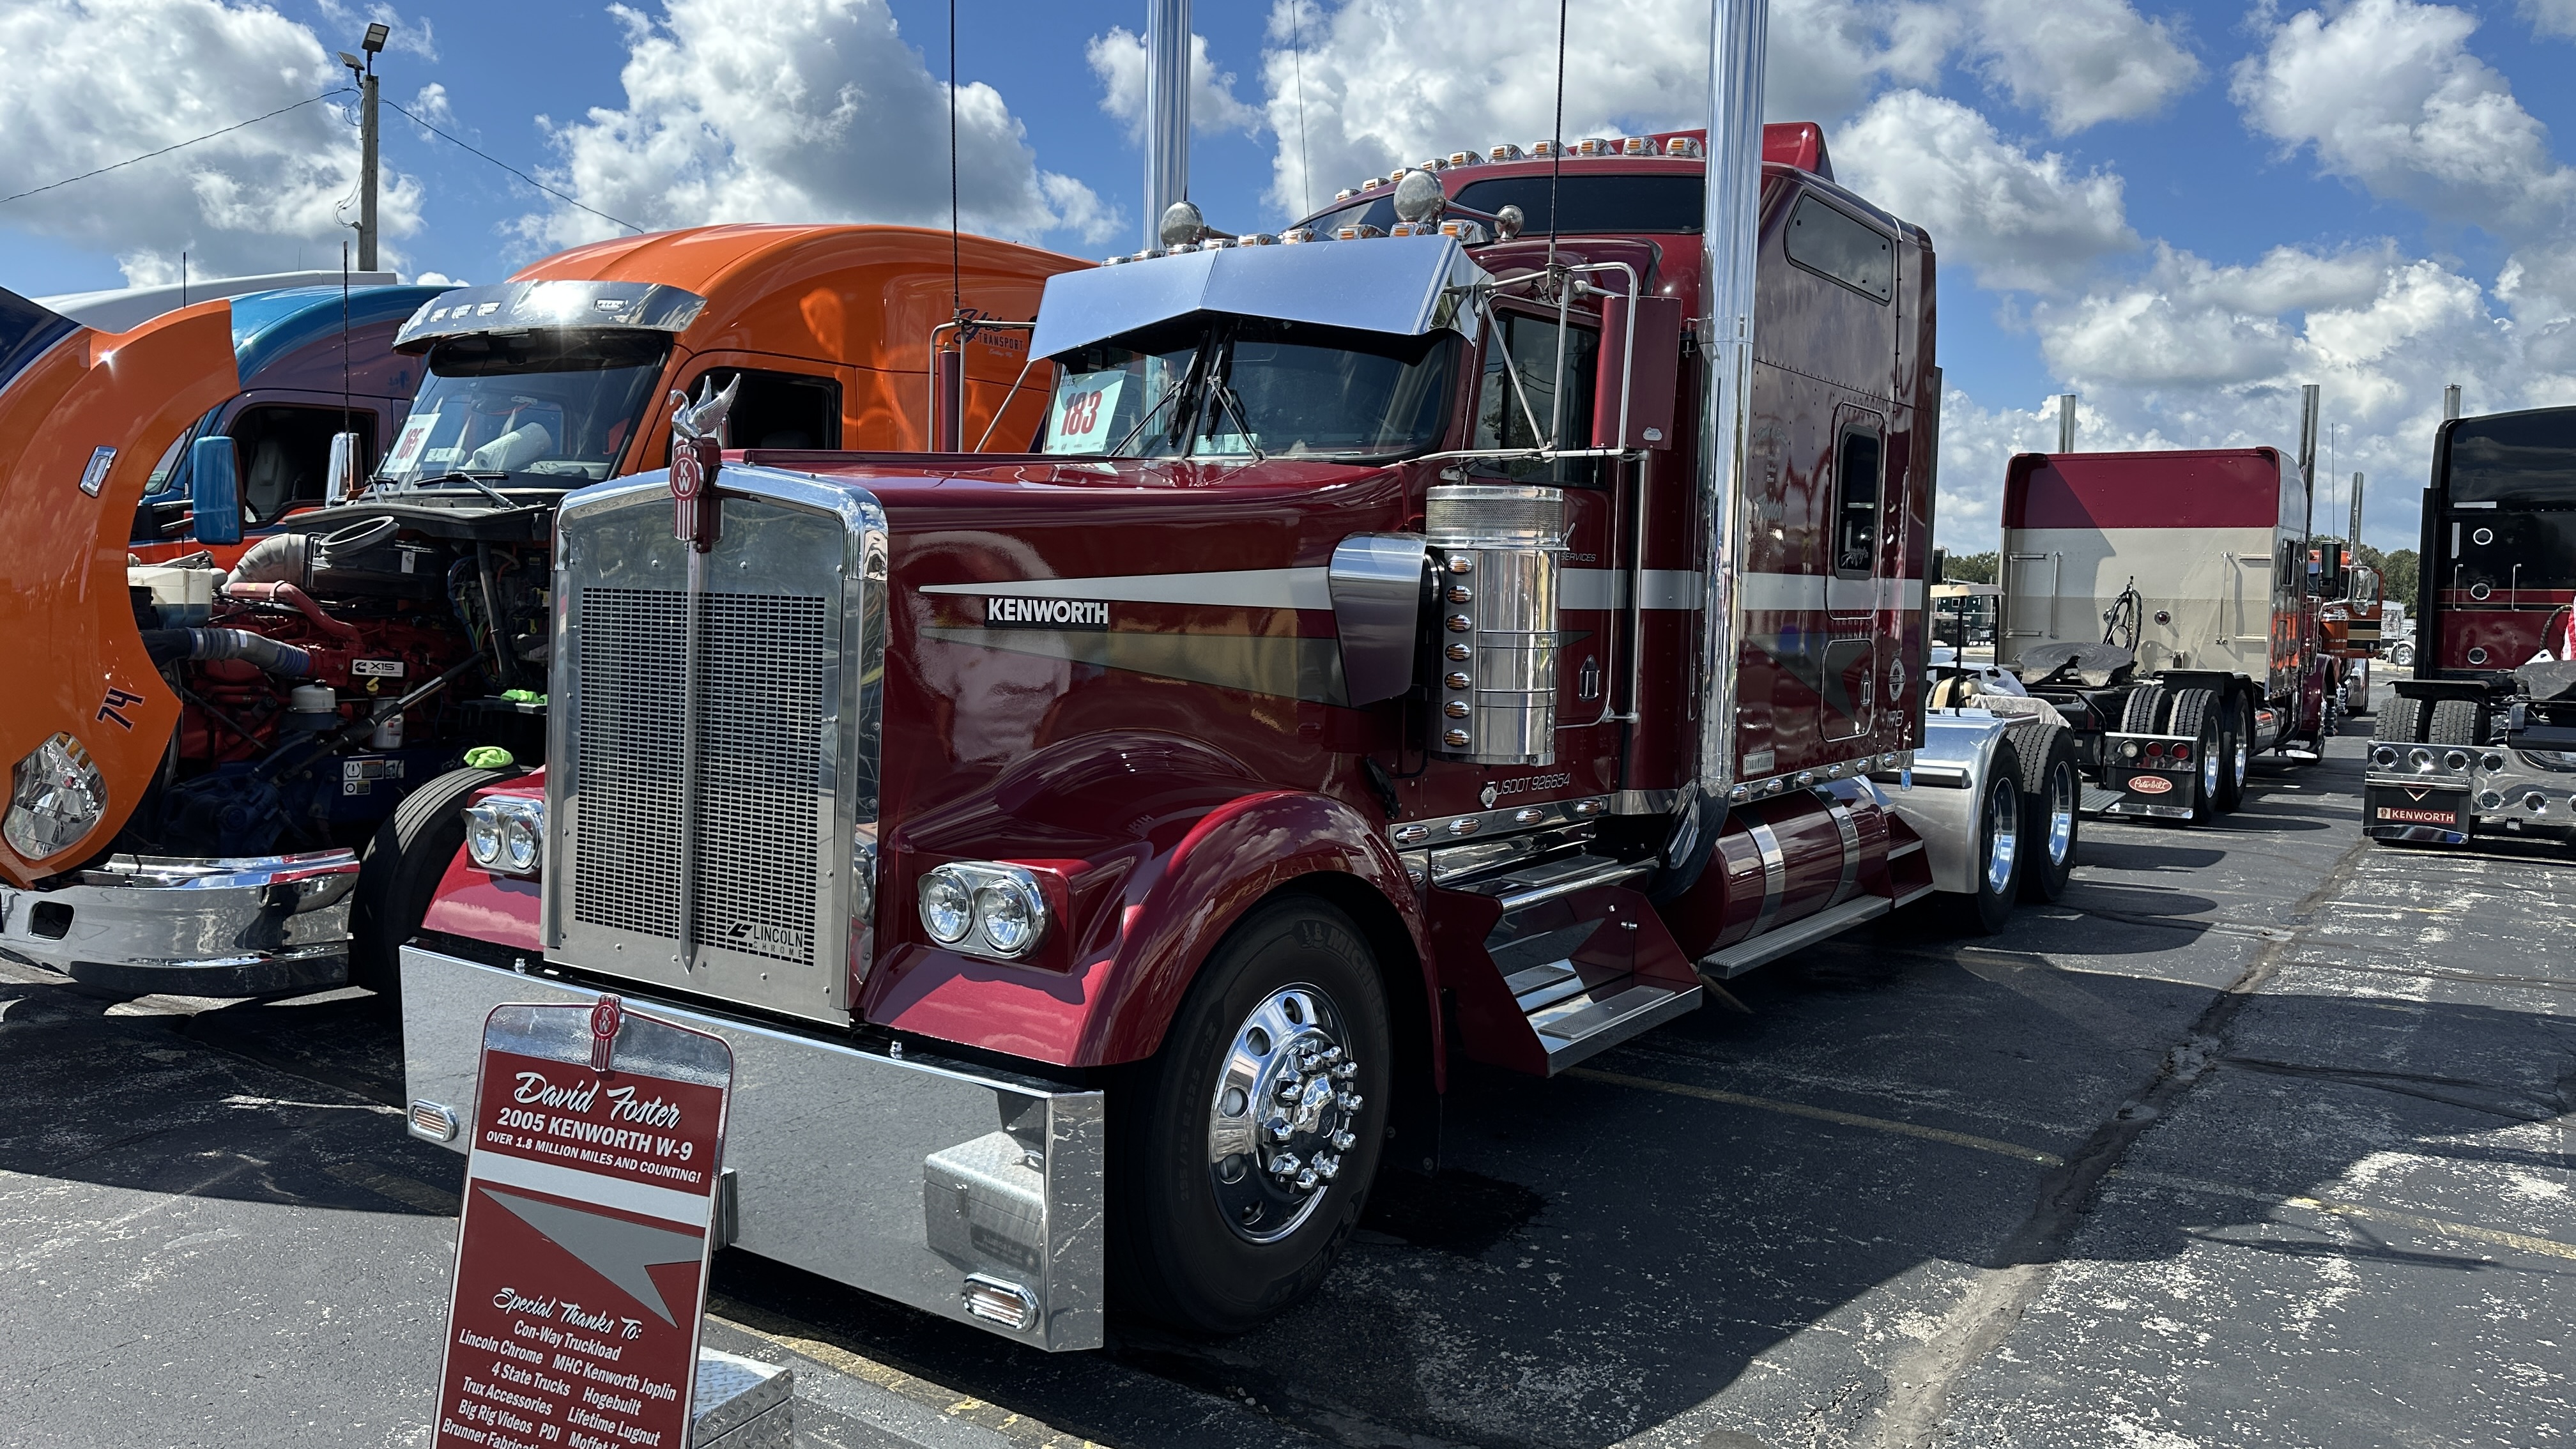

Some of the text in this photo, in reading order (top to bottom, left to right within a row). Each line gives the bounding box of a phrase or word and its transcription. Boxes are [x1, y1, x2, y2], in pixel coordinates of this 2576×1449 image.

[978, 333, 1023, 350] TRANSPORT
[1061, 378, 1076, 387] 2025
[1061, 390, 1102, 436] 183
[988, 598, 1108, 624] KENWORTH
[369, 662, 395, 671] X15
[95, 686, 146, 732] 74
[1496, 772, 1570, 795] USDOT 926654
[2134, 778, 2169, 790] Peterbilt
[2392, 809, 2454, 822] KENWORTH
[753, 940, 802, 958] CHROME
[754, 924, 803, 948] LINCOLN
[514, 1072, 681, 1129] David Foster
[497, 1108, 693, 1161] 2005 KENWORTH W-9
[486, 1130, 702, 1183] OVER 1.8 MILLION MILES AND COUNTING!
[493, 1287, 643, 1340] Special Thanks To:
[514, 1319, 622, 1361] Con-Way Truckload
[459, 1328, 677, 1401] Lincoln Chrome MHC Kenworth Joplin
[491, 1361, 641, 1416] 4 State Trucks Hogebuilt
[441, 1418, 487, 1444] Brunner
[458, 1399, 608, 1449] Big Rig Videos PDI Moffet
[463, 1376, 661, 1446] Trux Accessories Lifetime Lugnut
